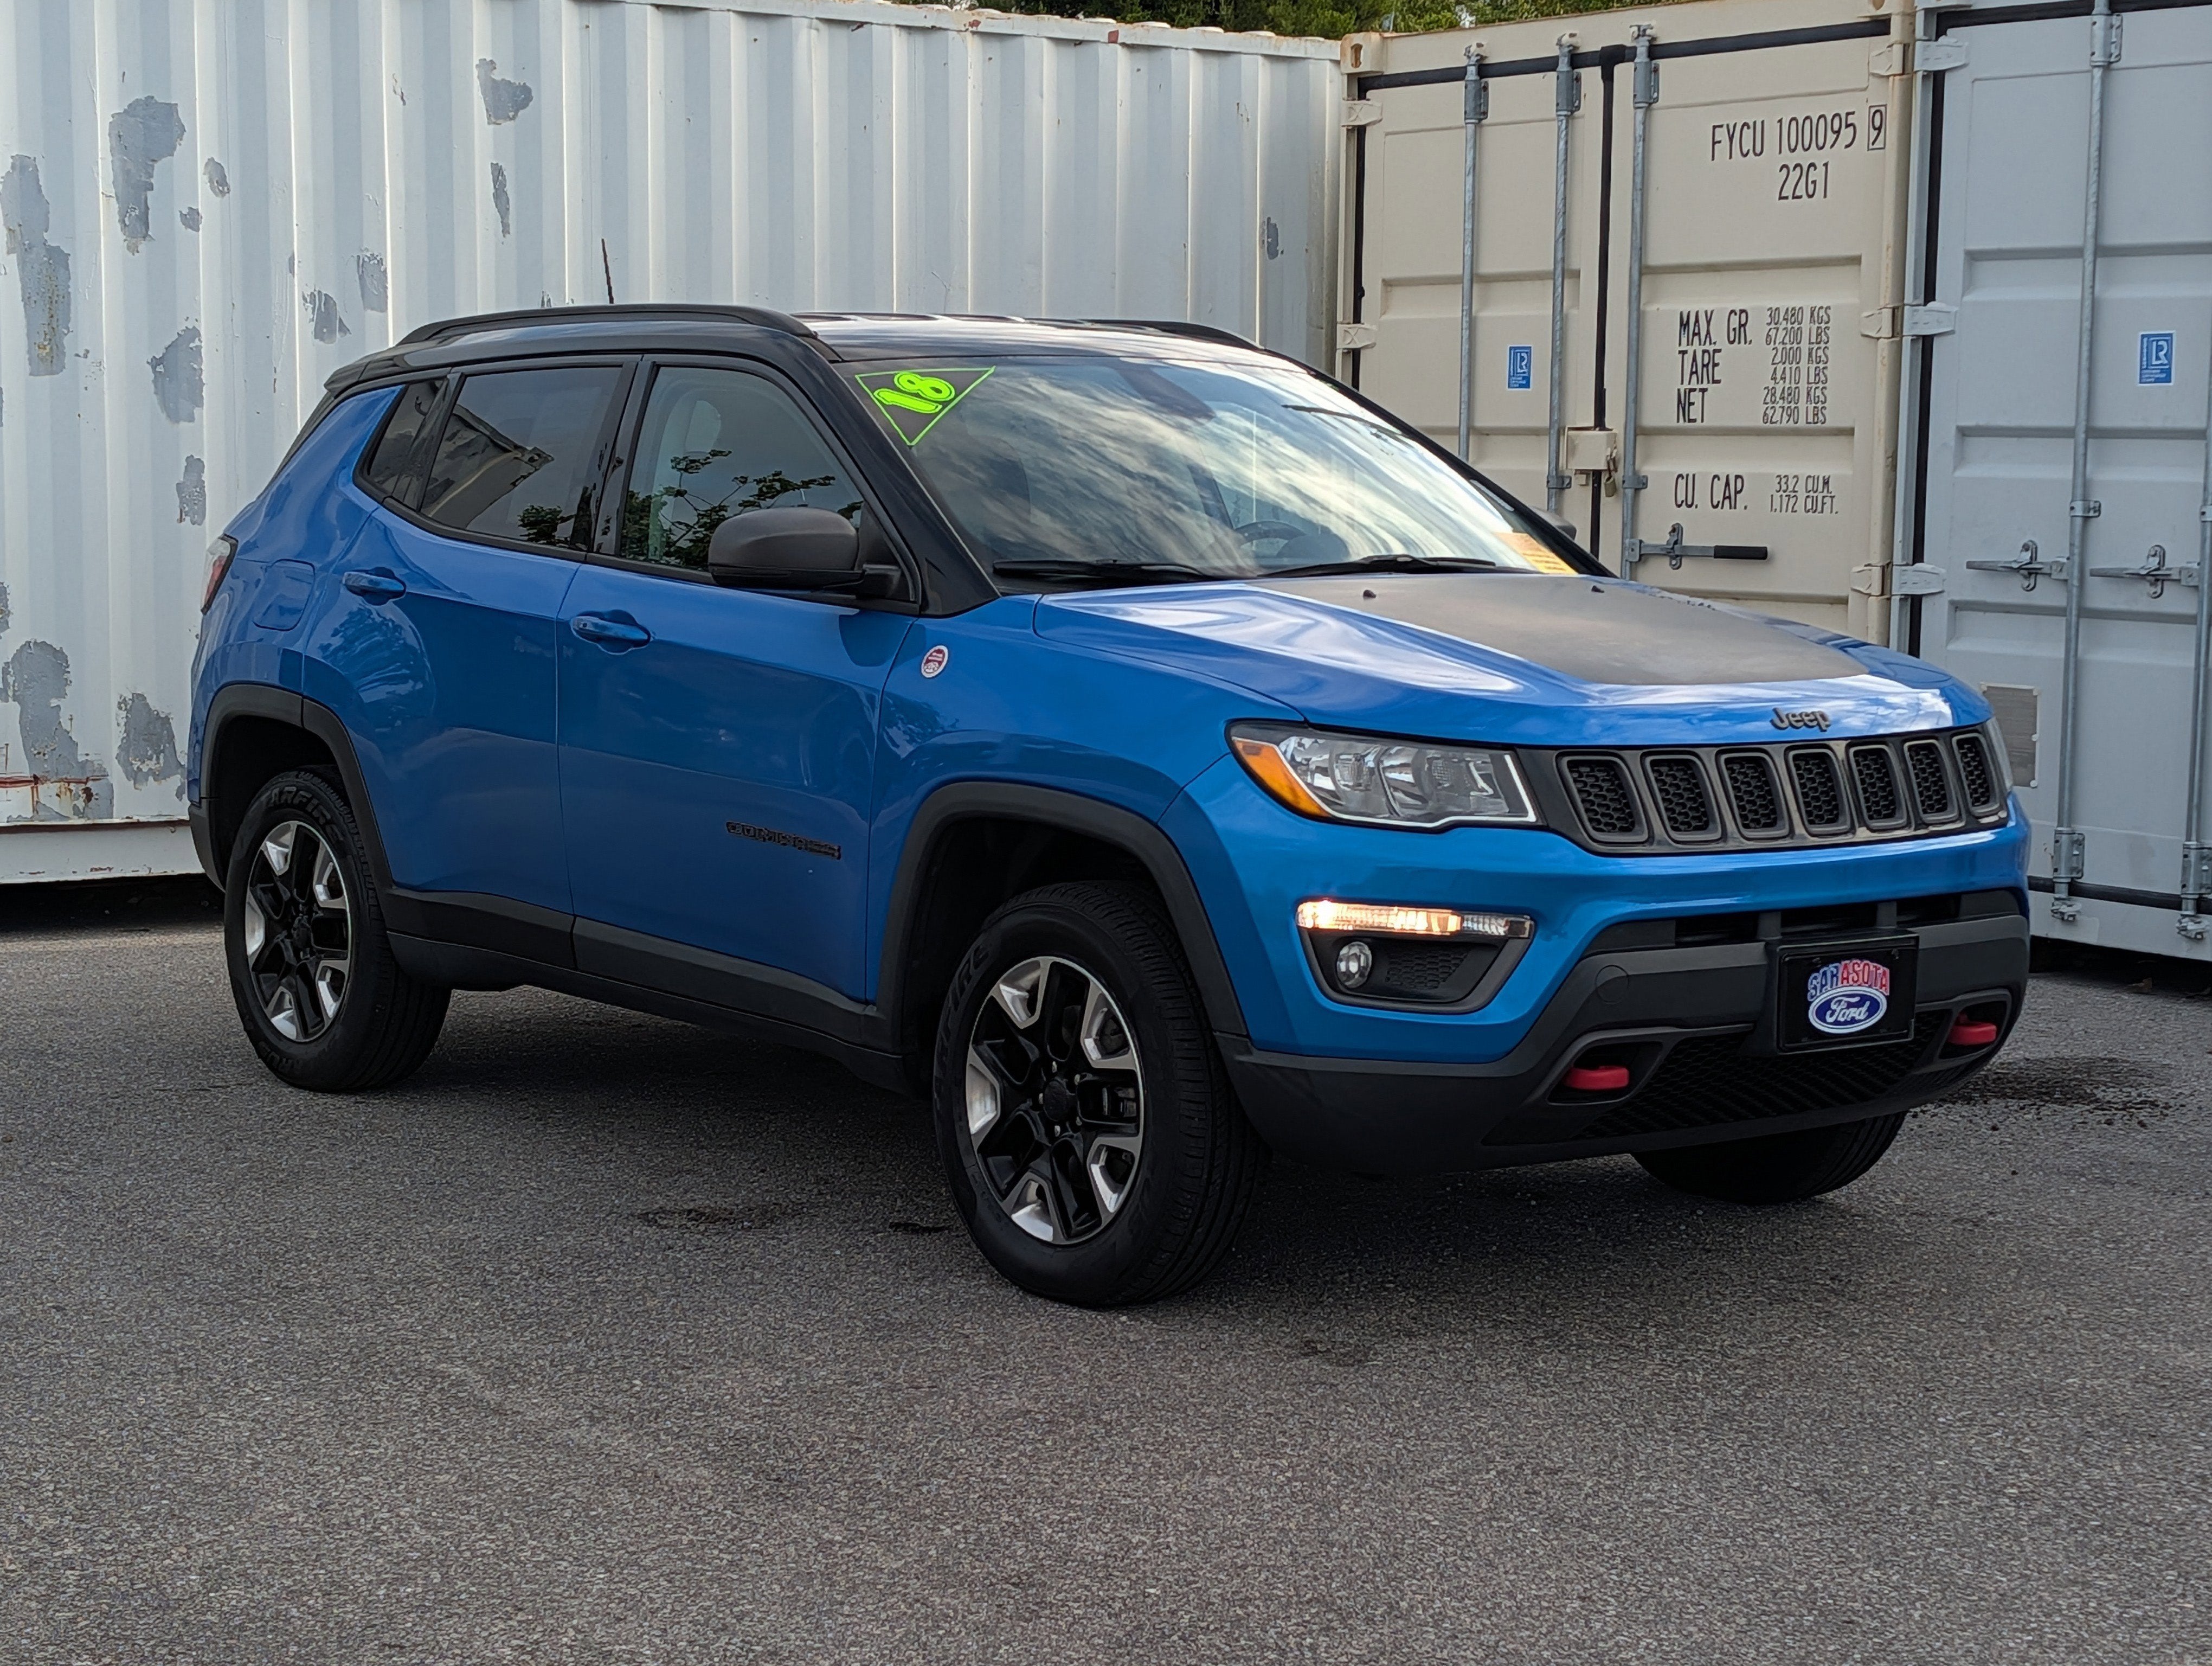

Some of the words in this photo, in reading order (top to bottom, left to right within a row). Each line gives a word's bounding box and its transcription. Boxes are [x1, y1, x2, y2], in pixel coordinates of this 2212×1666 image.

[1711, 120, 1765, 161] FYCU
[1777, 111, 1857, 155] 100095
[1870, 109, 1884, 146] 9
[1778, 161, 1829, 201] 22G1
[1678, 310, 1717, 347] MAX.
[1809, 305, 1831, 325] KGS
[1808, 326, 1830, 345] LBS
[1678, 349, 1722, 385] TARE
[1807, 346, 1829, 365] KGS
[1807, 366, 1828, 385] LBS
[873, 371, 956, 414] 18
[1676, 388, 1708, 423] NET
[1806, 386, 1827, 405] KGS
[1805, 406, 1827, 425] LBS
[1674, 473, 1698, 509] CU.
[1710, 474, 1748, 510] CAP.
[1770, 707, 1830, 732] Jeep
[1807, 959, 1890, 1002] SARASOTA
[1825, 996, 1870, 1023] Ford
